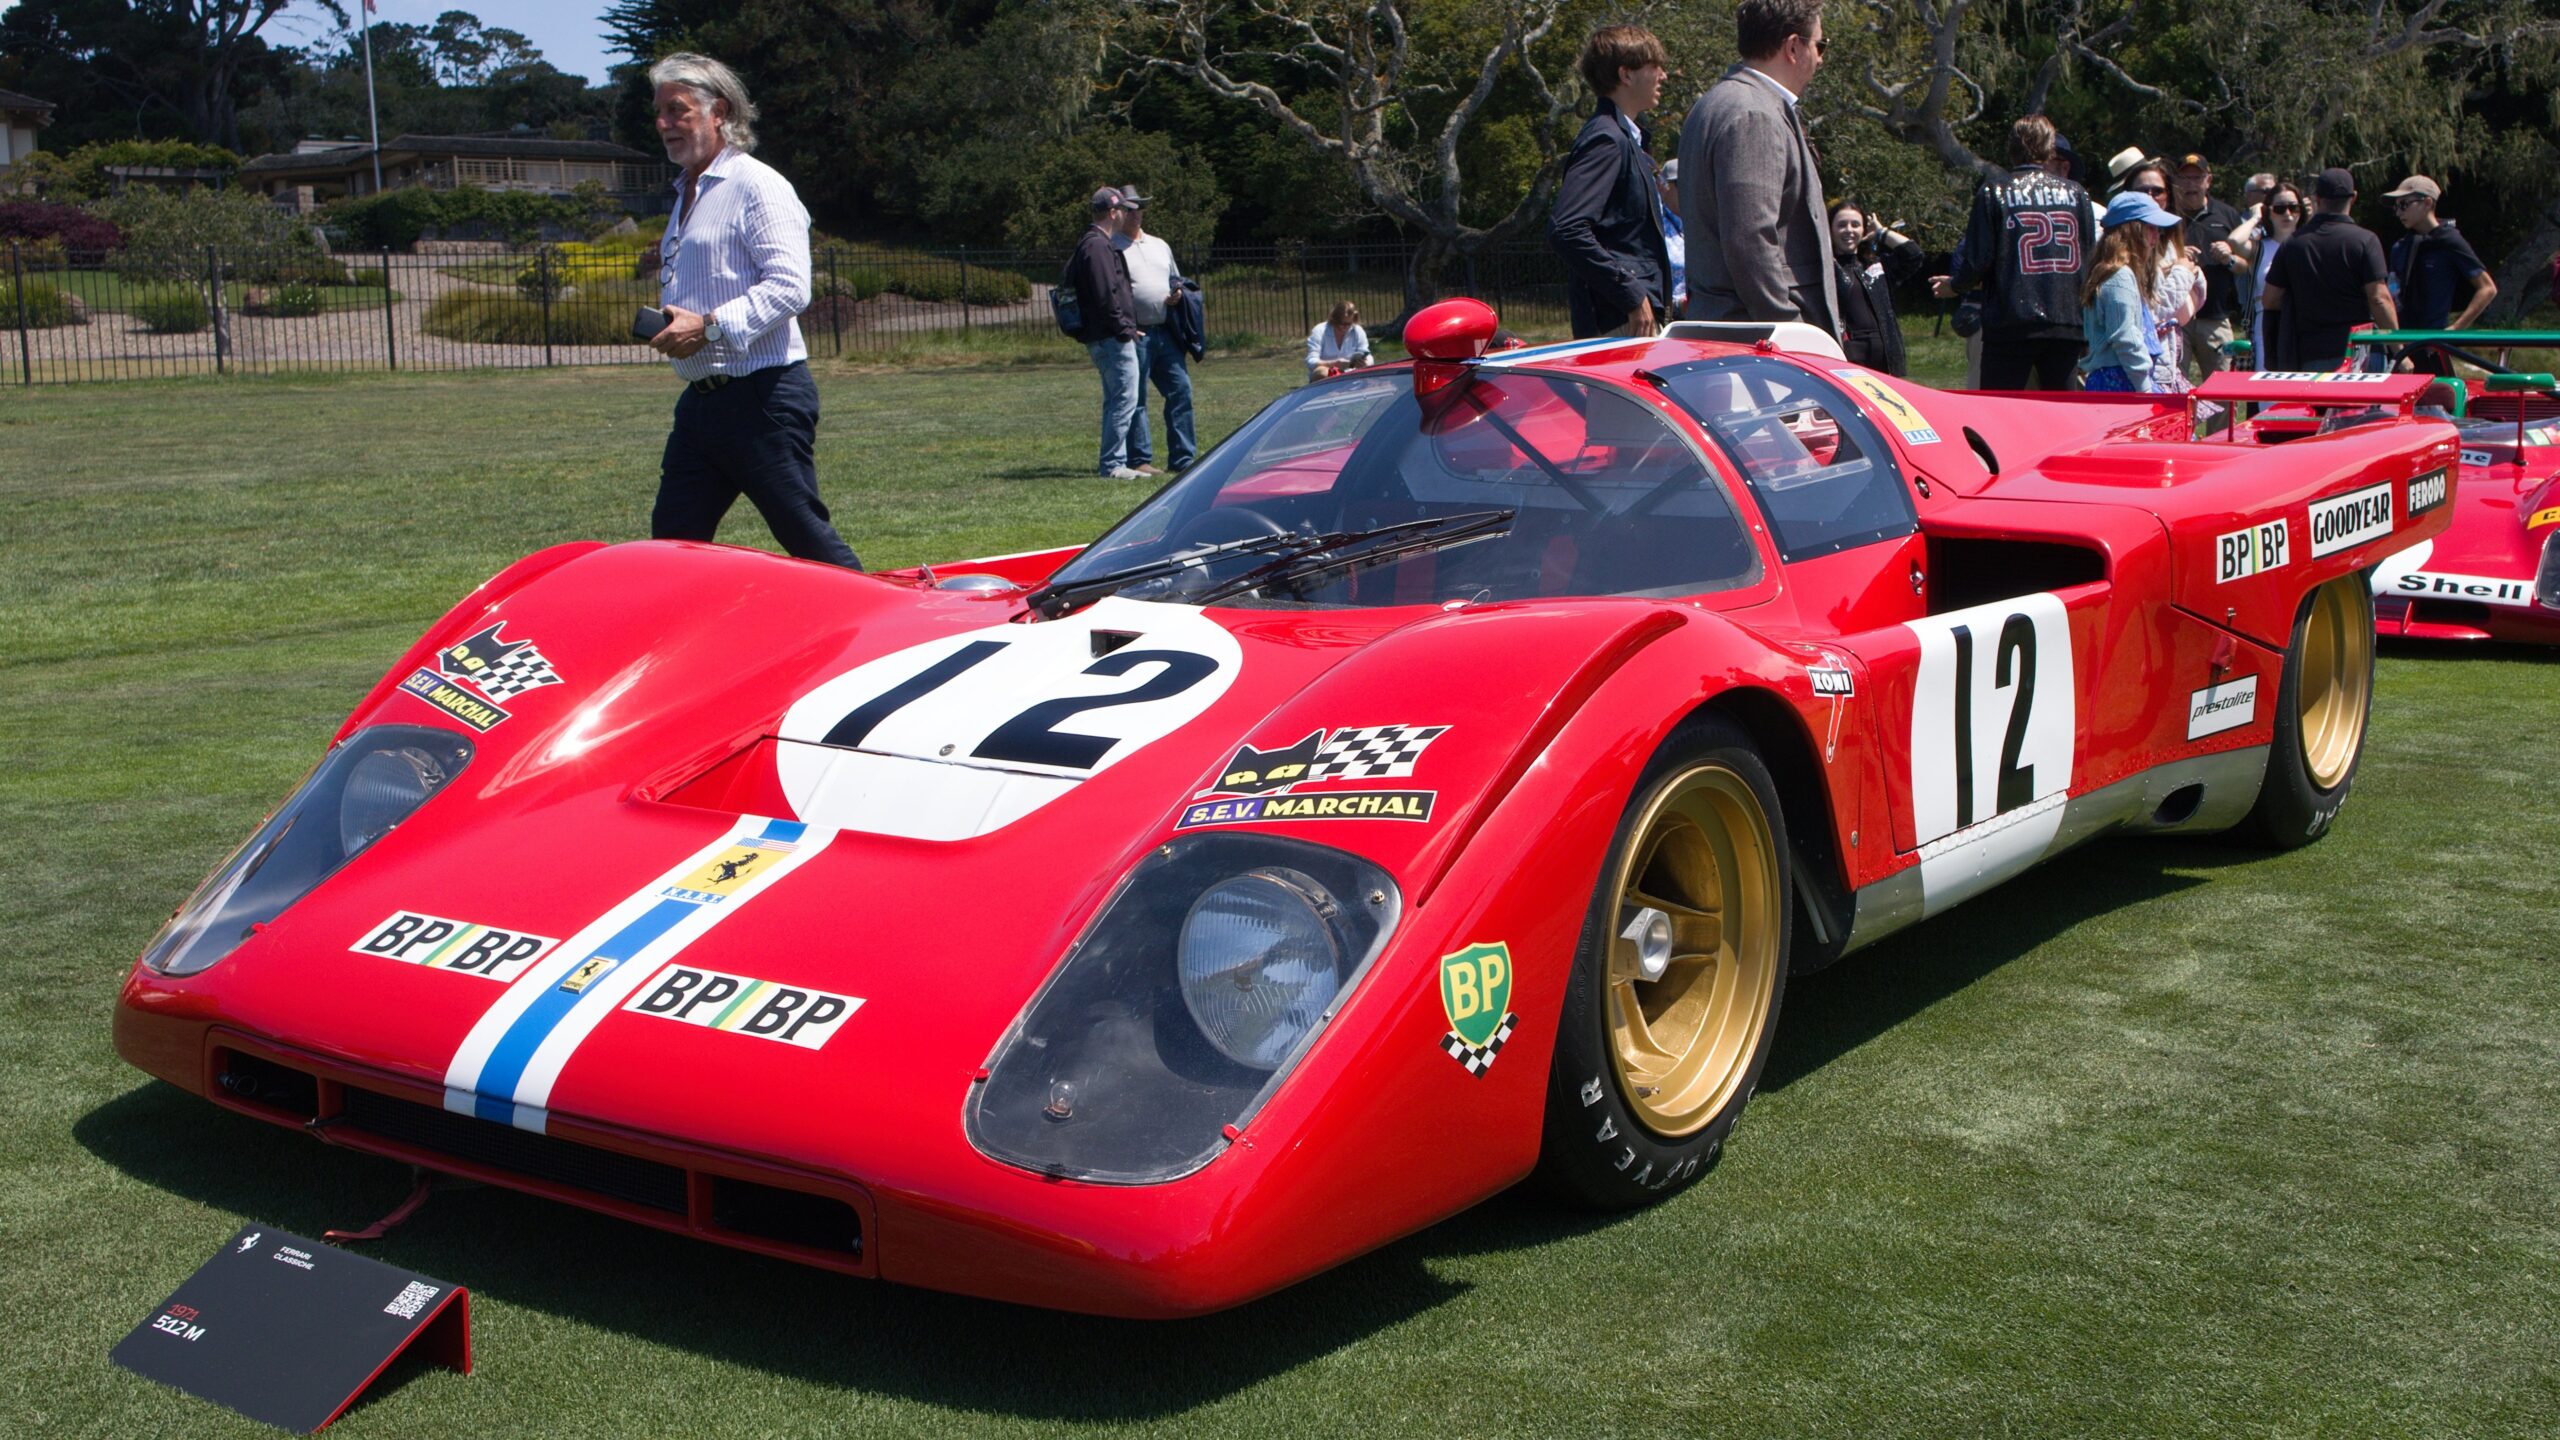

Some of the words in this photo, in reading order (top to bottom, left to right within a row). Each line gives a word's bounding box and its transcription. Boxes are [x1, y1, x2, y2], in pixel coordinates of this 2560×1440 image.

[2006, 186, 2033, 208] LAS
[2035, 185, 2077, 207] VEGAS
[2408, 473, 2446, 512] FERODO
[2313, 492, 2391, 545] GOODYEAR
[2221, 533, 2250, 581] BP
[2260, 523, 2286, 569] BP
[2397, 574, 2523, 600] Shell
[1810, 672, 1851, 692] KONI
[404, 672, 439, 695] S.E.V.
[427, 684, 498, 728] MARCHAL
[820, 640, 1220, 770] 12
[2191, 690, 2255, 722] prestolite
[1950, 612, 2037, 830] 12
[1189, 801, 1255, 823] S.E.V.
[1262, 796, 1424, 817] MARCHAL
[361, 914, 453, 967] BP
[446, 930, 543, 976] BP
[636, 968, 740, 1019] BP
[740, 986, 848, 1040] BP
[1446, 953, 1506, 1022] BP
[272, 1252, 315, 1271] CLASSICHE
[279, 1245, 313, 1260] FERRARI
[152, 1314, 189, 1336] 512
[182, 1327, 206, 1342] M
[167, 1303, 200, 1322] 1971
